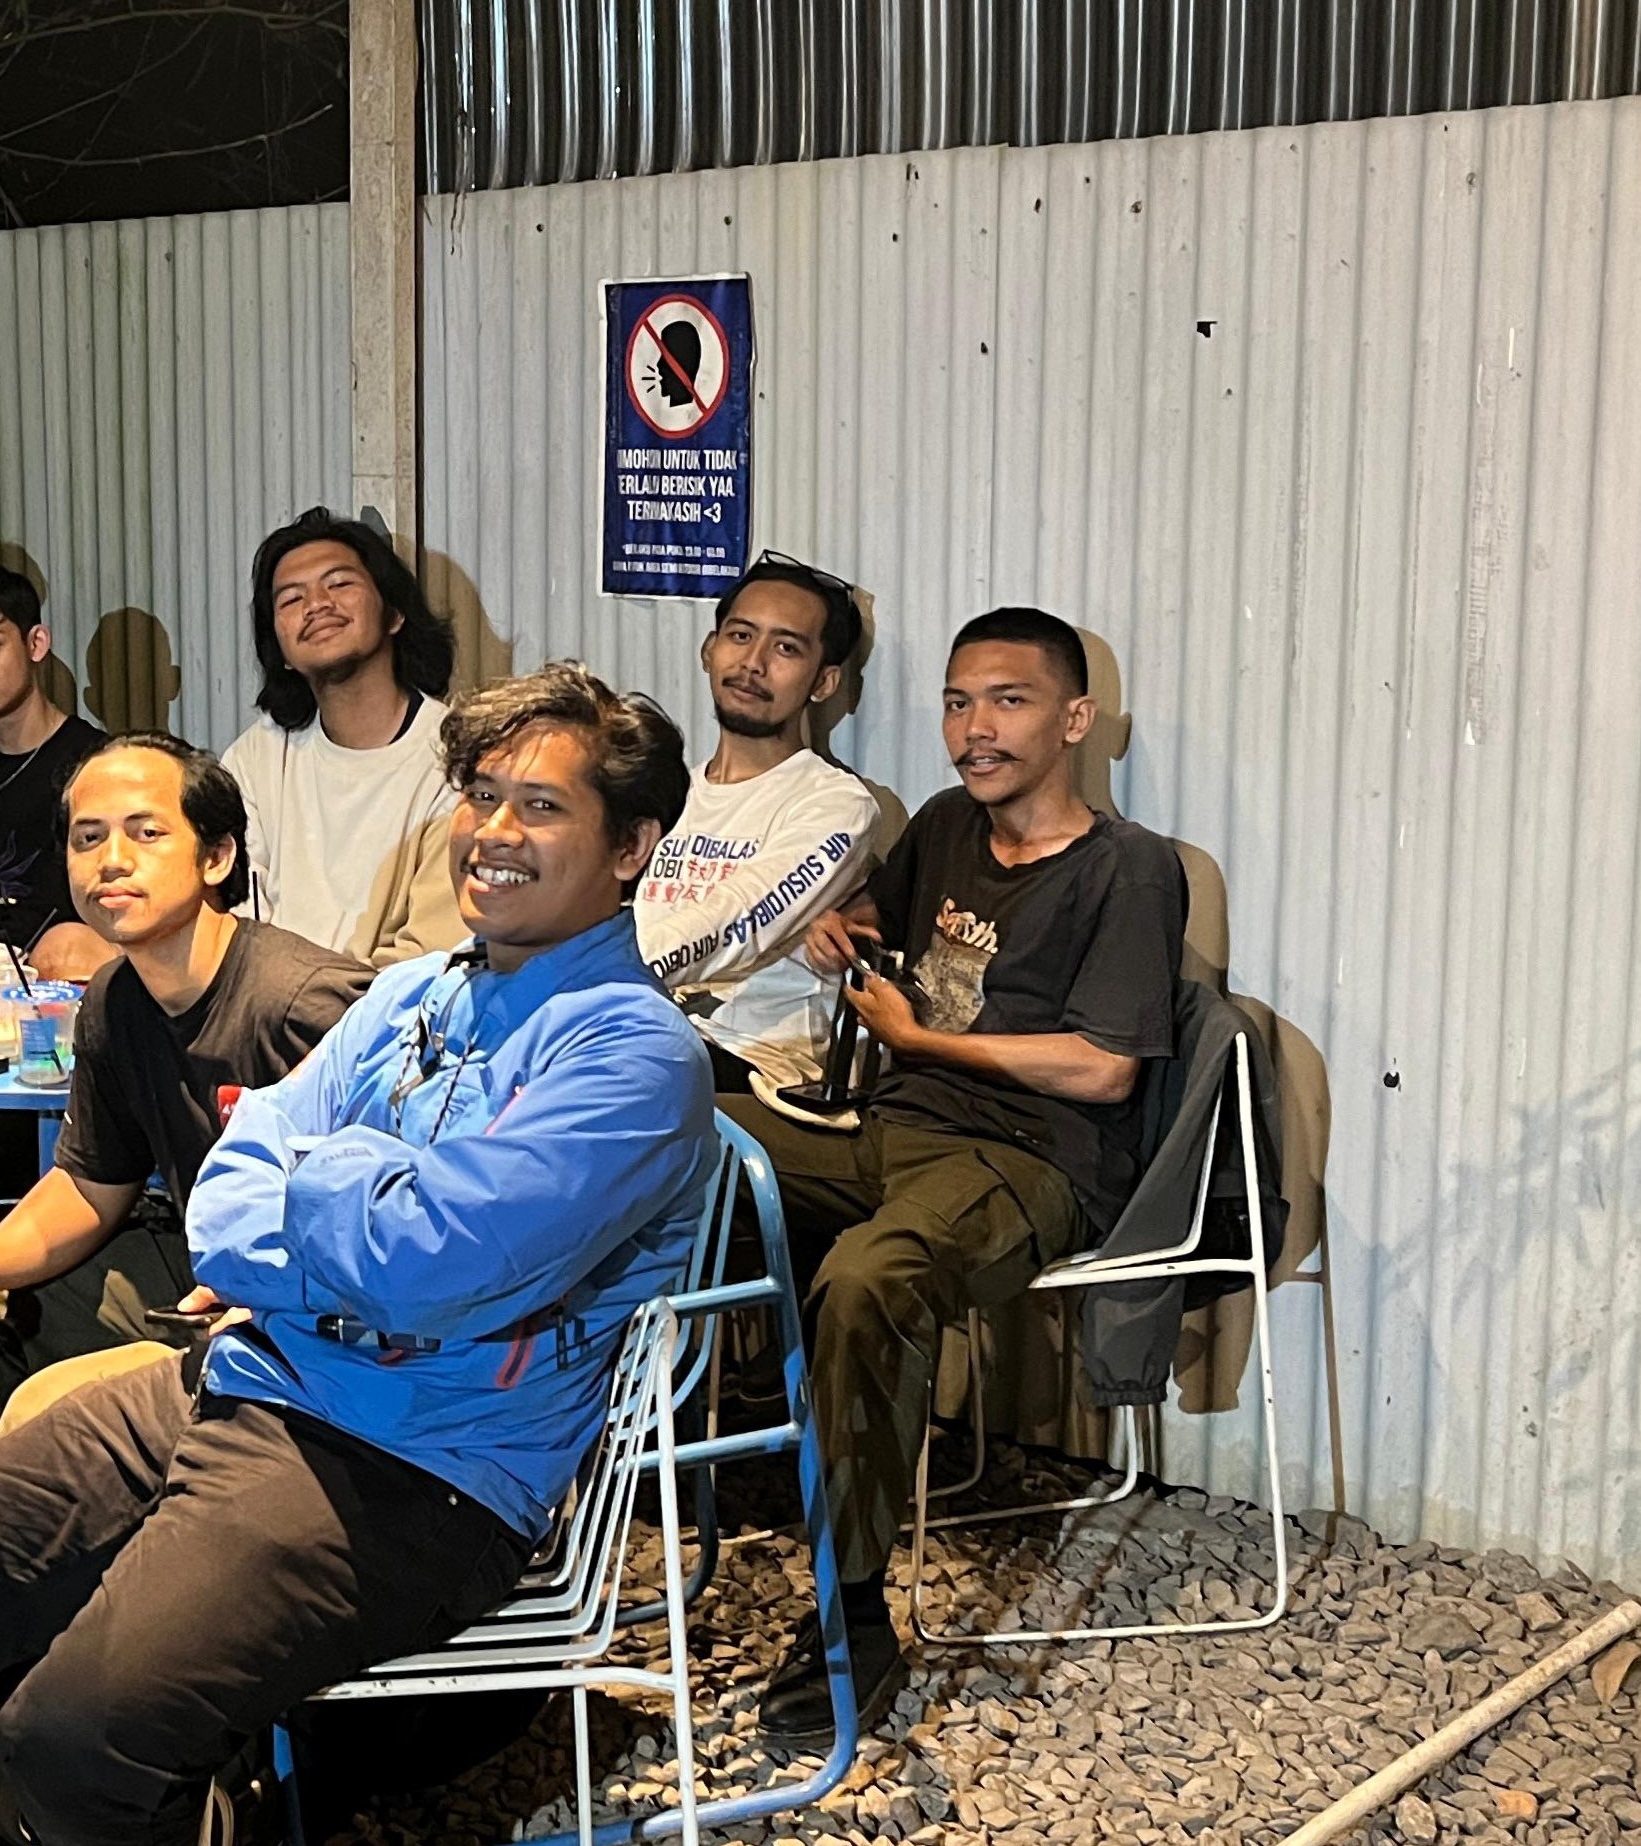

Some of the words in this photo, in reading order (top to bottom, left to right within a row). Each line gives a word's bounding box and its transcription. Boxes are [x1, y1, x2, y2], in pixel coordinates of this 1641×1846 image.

[663, 449, 701, 470] UNTUK
[703, 449, 738, 470] TIDAK
[661, 476, 706, 497] BERISIK
[691, 835, 758, 859] DIBALAS
[819, 832, 852, 863] AIR
[778, 855, 825, 905] SUSU
[693, 930, 720, 962] AIR
